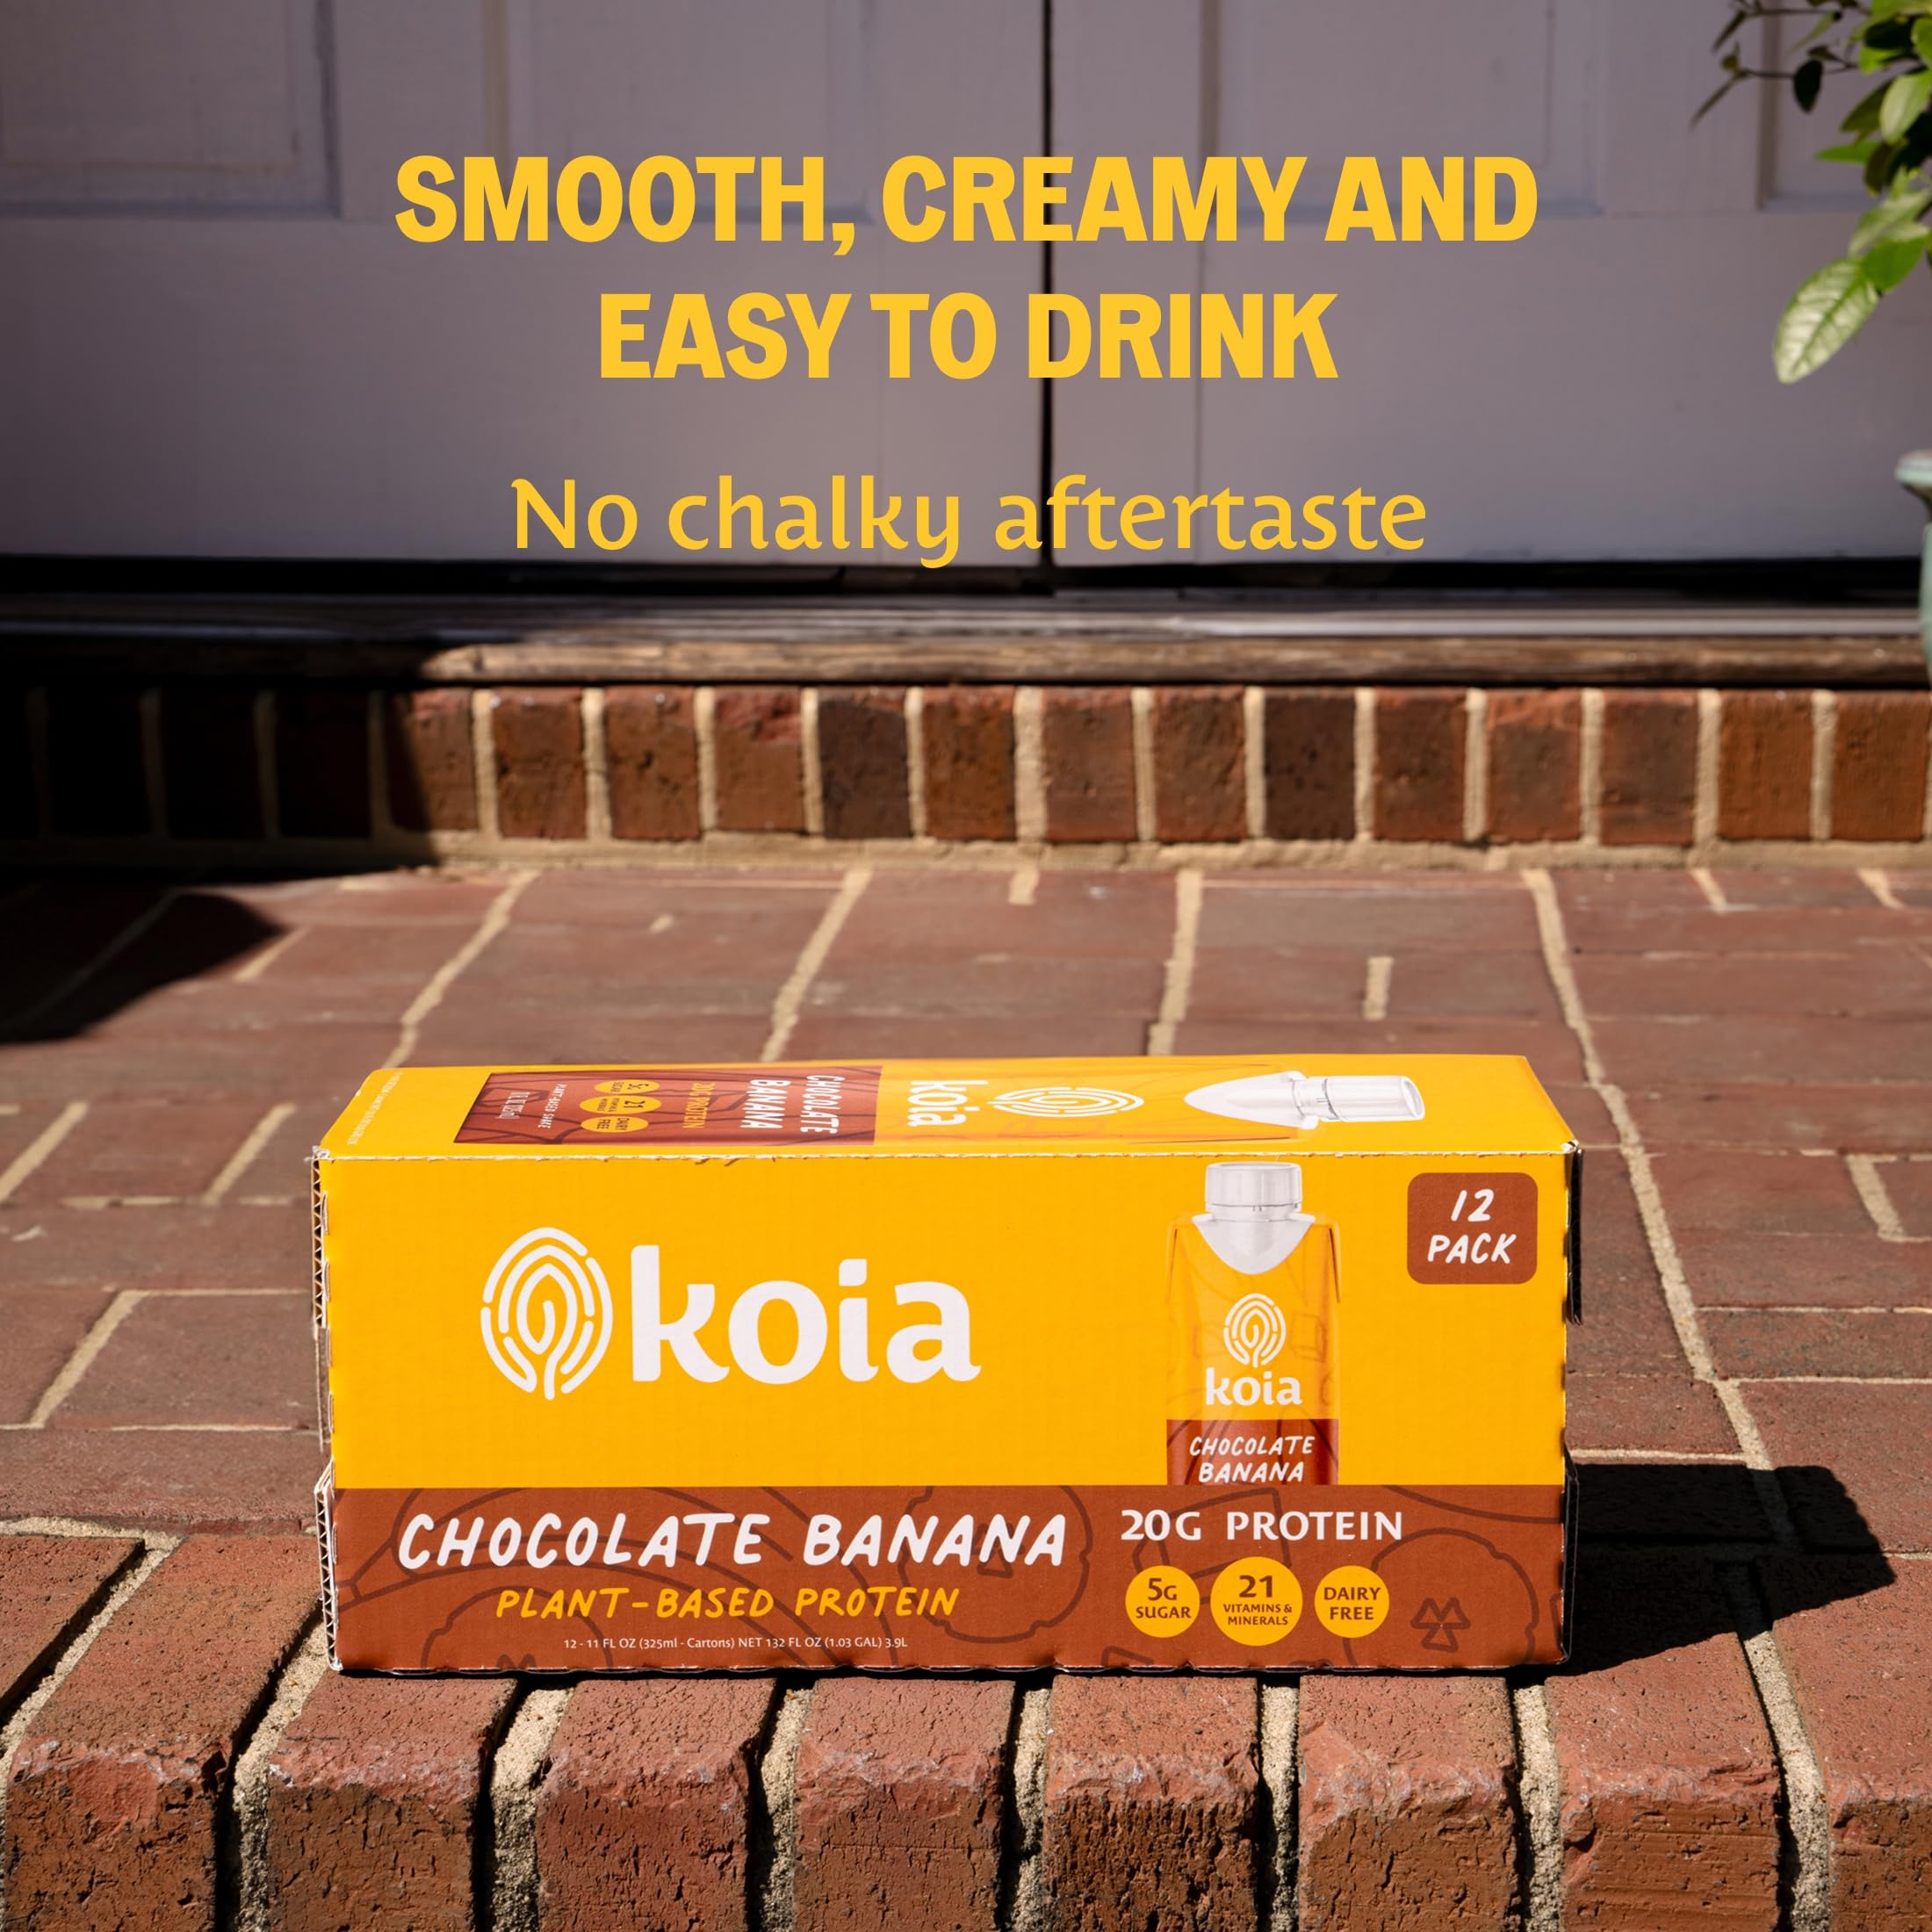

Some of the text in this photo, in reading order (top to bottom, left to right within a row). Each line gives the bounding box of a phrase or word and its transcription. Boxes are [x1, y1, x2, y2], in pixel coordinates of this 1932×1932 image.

[682, 1097, 709, 1128] PROTEIN
[740, 1078, 791, 1128] BANANA
[800, 1075, 846, 1134] CHOCOLATE
[907, 1079, 989, 1127] koia
[1450, 1188, 1495, 1222] 12
[1427, 1232, 1517, 1265] PACK
[631, 1244, 981, 1385] koia
[1206, 1366, 1301, 1406] koia
[1189, 1436, 1316, 1458] CHOCOLATE
[1198, 1461, 1304, 1484] BANANA
[399, 1512, 1066, 1569] CHOCOLATE BANANA
[1121, 1509, 1402, 1541] 20G PROTEIN
[1147, 1577, 1178, 1601] 5G
[1238, 1575, 1274, 1598] 21
[1323, 1587, 1381, 1601] DAIRY
[496, 1586, 960, 1619] PLANT-BASED PROTEIN
[1135, 1606, 1192, 1619] SUGAR
[1223, 1604, 1281, 1613] VITAMINS
[1330, 1606, 1374, 1620] FREE
[1227, 1616, 1289, 1626] MINERALS
[563, 1639, 577, 1649] 12
[587, 1639, 599, 1648] 11
[602, 1638, 616, 1648] FL
[618, 1638, 637, 1649] OZ
[638, 1637, 678, 1651] (325ml
[687, 1637, 735, 1650] Cartons)
[738, 1637, 763, 1648] NET
[766, 1637, 786, 1648] 132
[789, 1637, 802, 1648] FL
[804, 1637, 822, 1648] OZ
[825, 1636, 852, 1650] (1.03
[854, 1636, 883, 1650] GAL)
[885, 1637, 908, 1648] 3.9L
